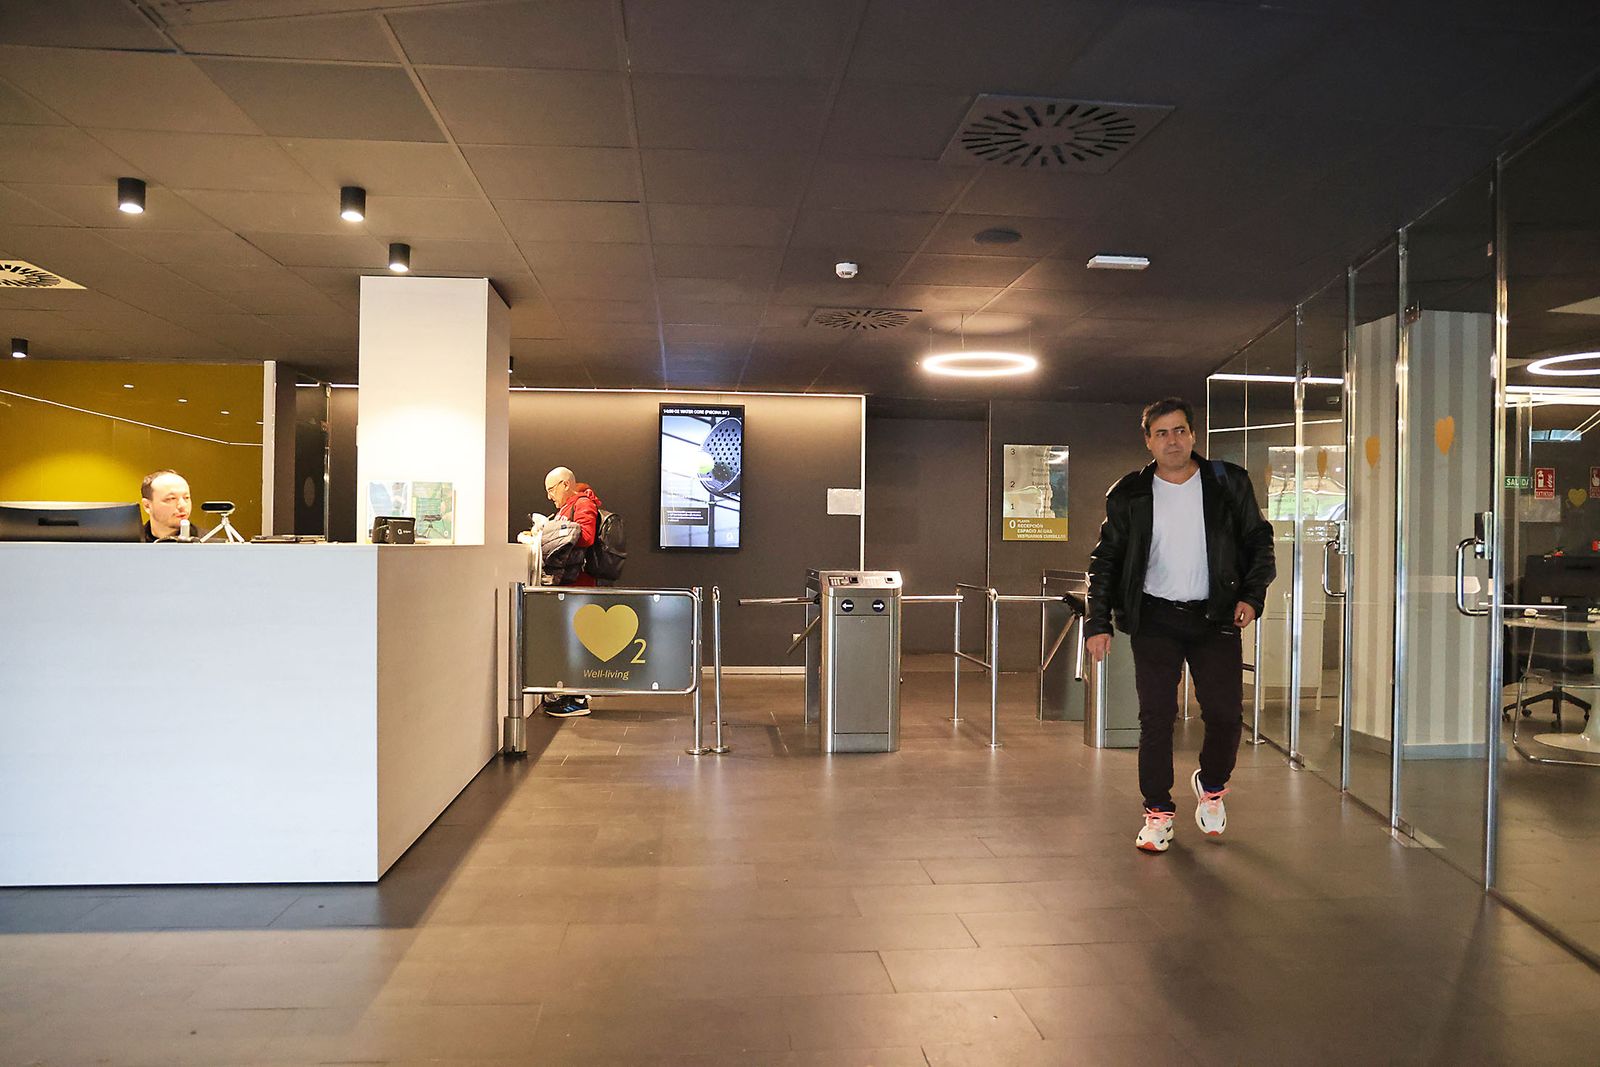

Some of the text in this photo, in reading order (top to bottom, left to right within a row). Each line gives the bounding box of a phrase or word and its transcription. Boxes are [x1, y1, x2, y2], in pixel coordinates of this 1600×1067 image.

[1010, 480, 1015, 488] 2
[1009, 520, 1016, 529] 0
[630, 638, 647, 664] 2
[583, 669, 630, 681] Well-living
